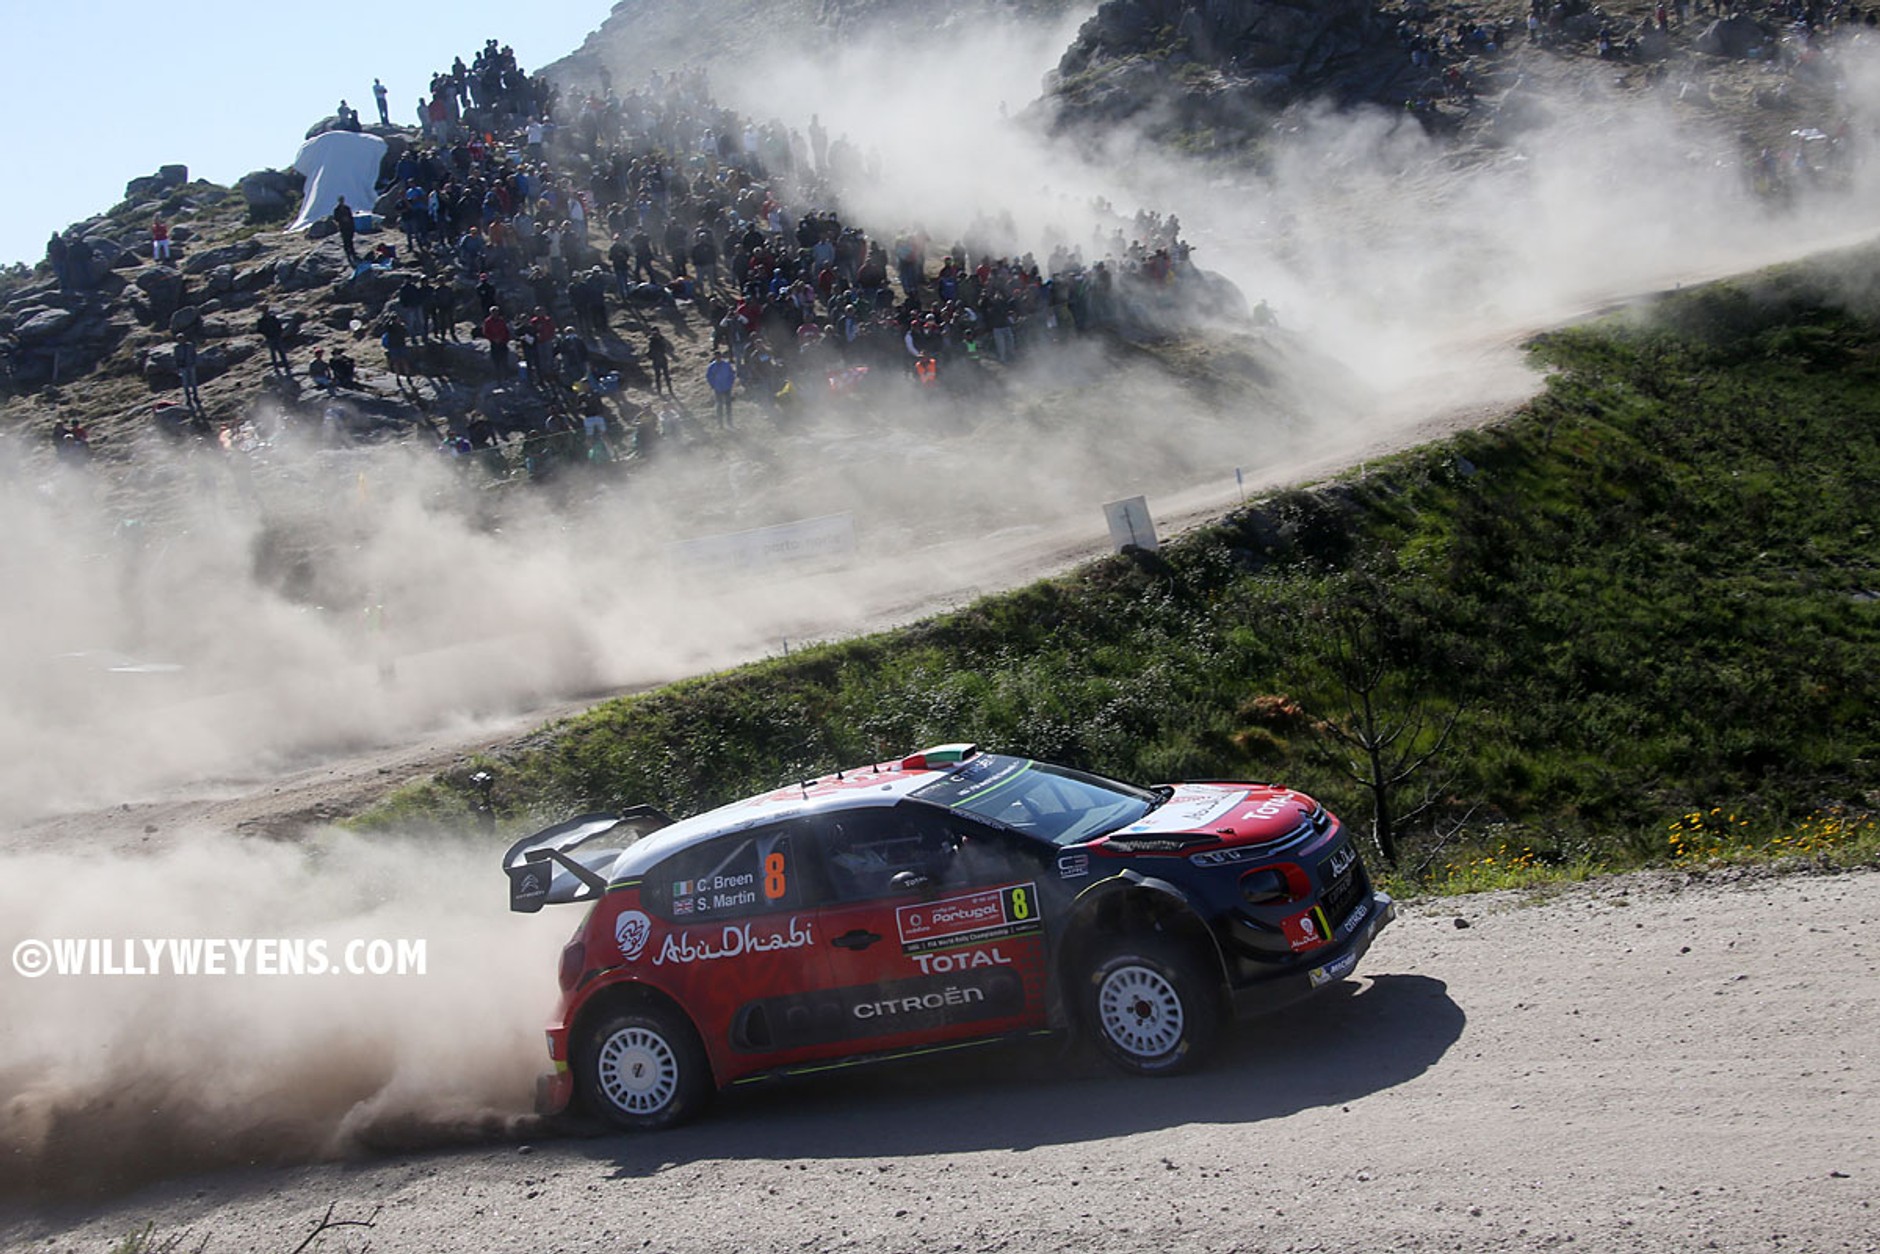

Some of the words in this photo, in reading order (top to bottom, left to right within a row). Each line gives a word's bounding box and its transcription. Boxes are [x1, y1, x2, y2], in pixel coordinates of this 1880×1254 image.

[1058, 854, 1089, 870] C3
[696, 879, 712, 893] C.
[714, 873, 754, 890] Breen
[764, 853, 786, 899] 8
[697, 897, 712, 911] S.
[713, 891, 756, 909] Martin
[1011, 888, 1029, 920] 8
[932, 903, 999, 924] Portugal
[911, 948, 1012, 975] TOTAL
[853, 986, 985, 1019] CITROËN
